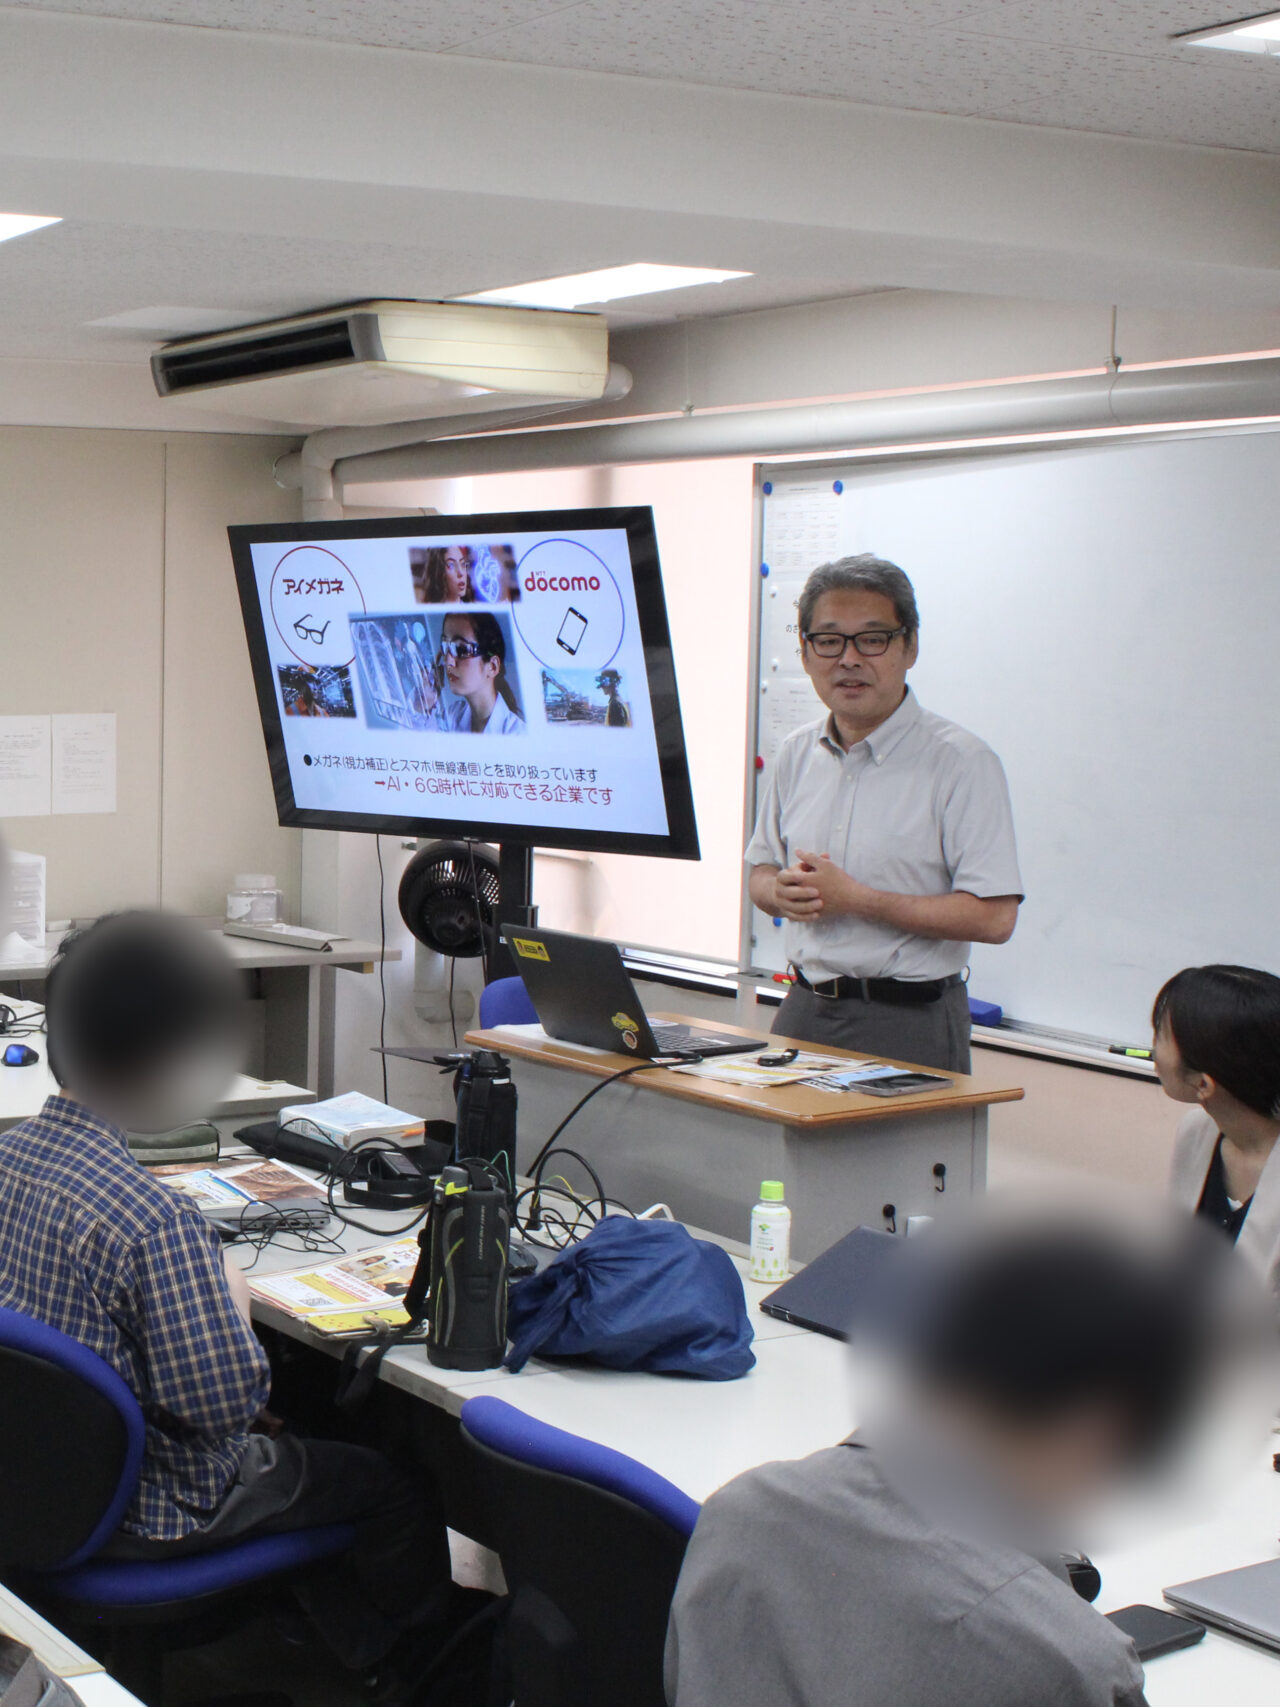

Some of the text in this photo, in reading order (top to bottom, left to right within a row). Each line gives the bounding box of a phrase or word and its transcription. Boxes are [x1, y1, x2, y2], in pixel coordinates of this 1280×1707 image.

[282, 578, 344, 595] アイメガネ
[524, 571, 600, 592] docomo
